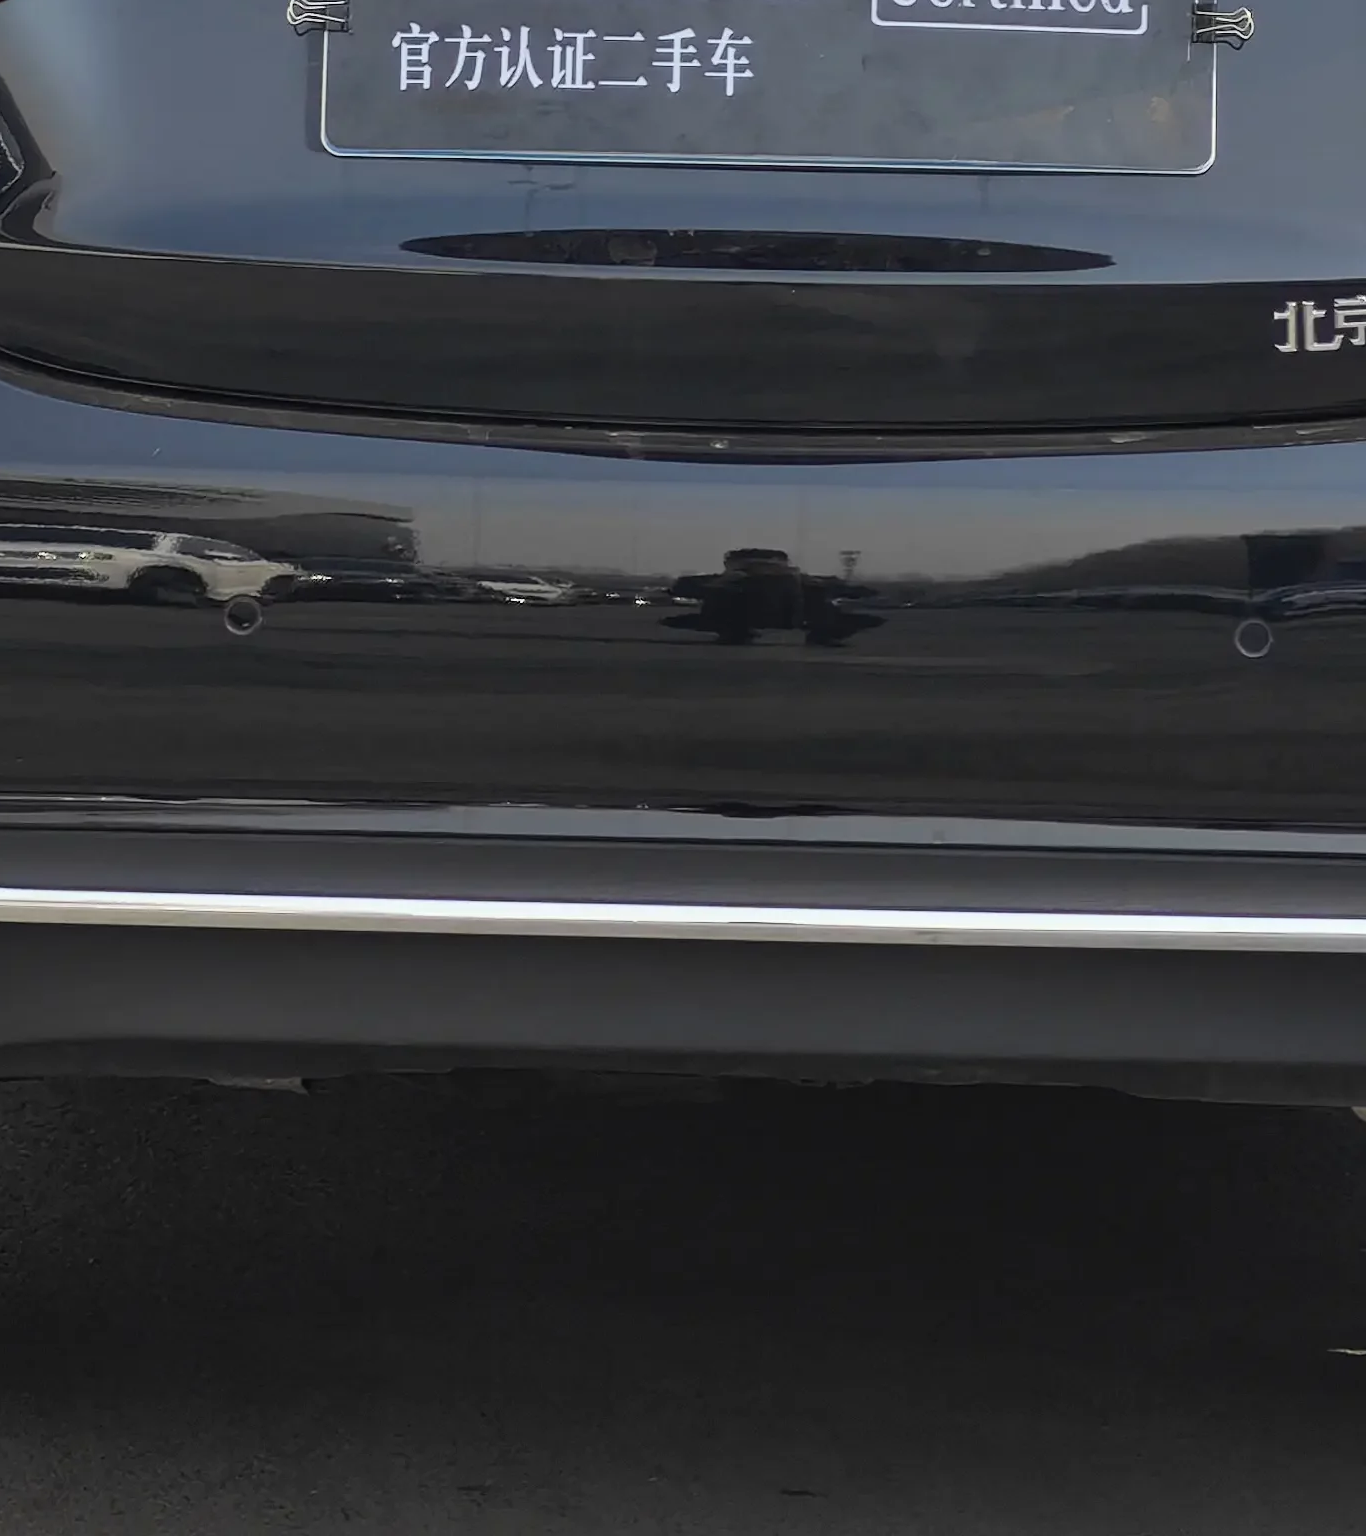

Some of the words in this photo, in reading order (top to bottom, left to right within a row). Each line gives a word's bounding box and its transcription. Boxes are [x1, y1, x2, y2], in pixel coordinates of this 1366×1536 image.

[392, 23, 755, 97] 官方认证二手车
